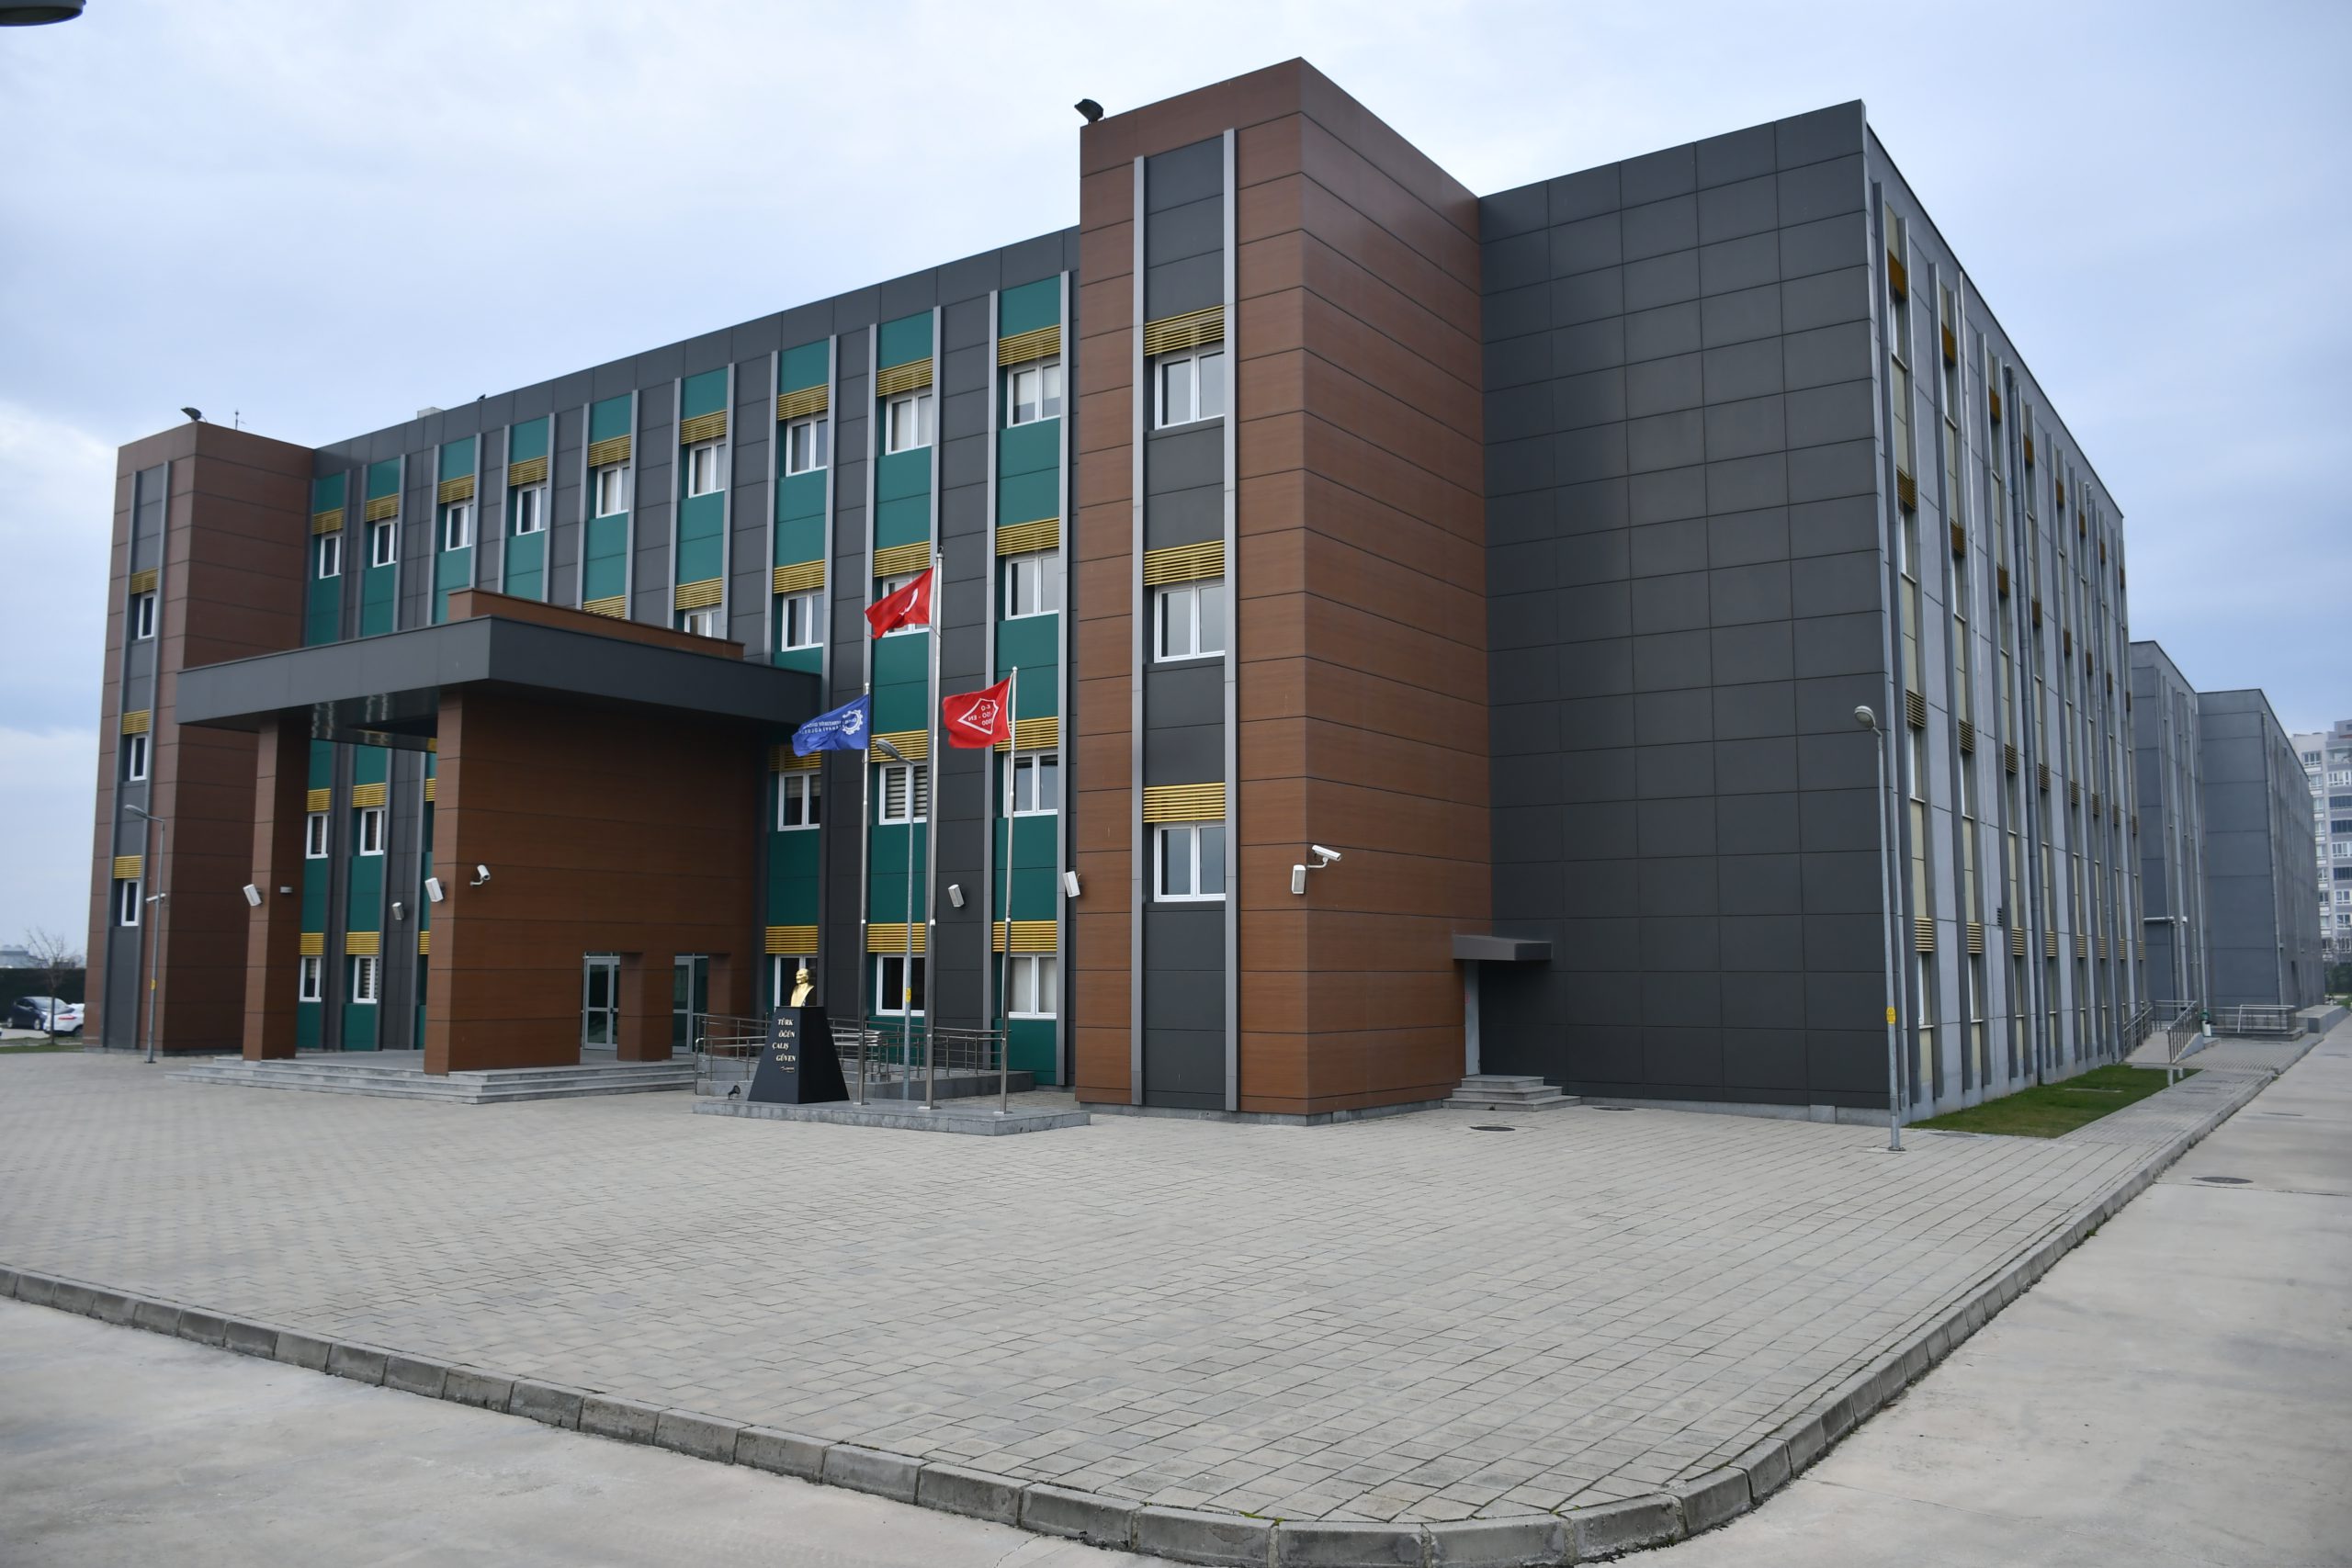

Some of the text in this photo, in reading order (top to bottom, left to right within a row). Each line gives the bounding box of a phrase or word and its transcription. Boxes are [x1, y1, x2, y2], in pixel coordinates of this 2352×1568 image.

[777, 1017, 794, 1026] TÜRK
[778, 1030, 795, 1038] ÖĞÜN
[772, 1042, 789, 1051] ÇALIŞ
[775, 1053, 796, 1062] GÜVEN
